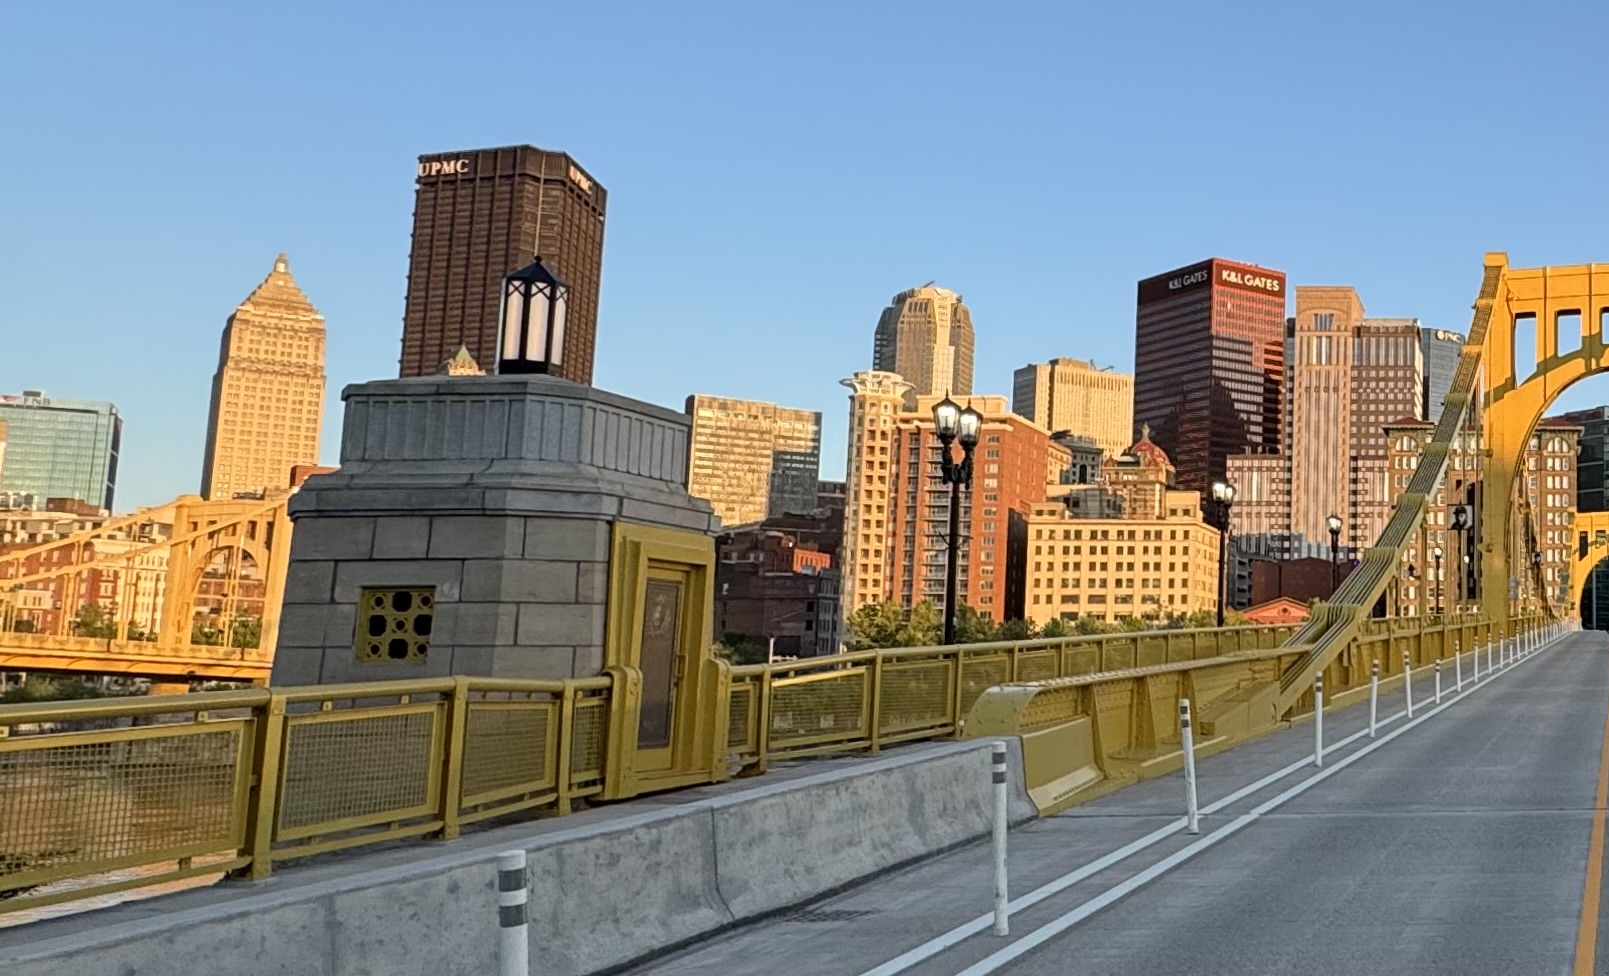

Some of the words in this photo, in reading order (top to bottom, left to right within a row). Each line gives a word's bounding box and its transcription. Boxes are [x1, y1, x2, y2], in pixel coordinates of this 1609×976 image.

[418, 159, 470, 177] UPMC
[1183, 270, 1208, 286] GATES
[1222, 269, 1244, 285] K&L
[1244, 273, 1280, 292] GATES
